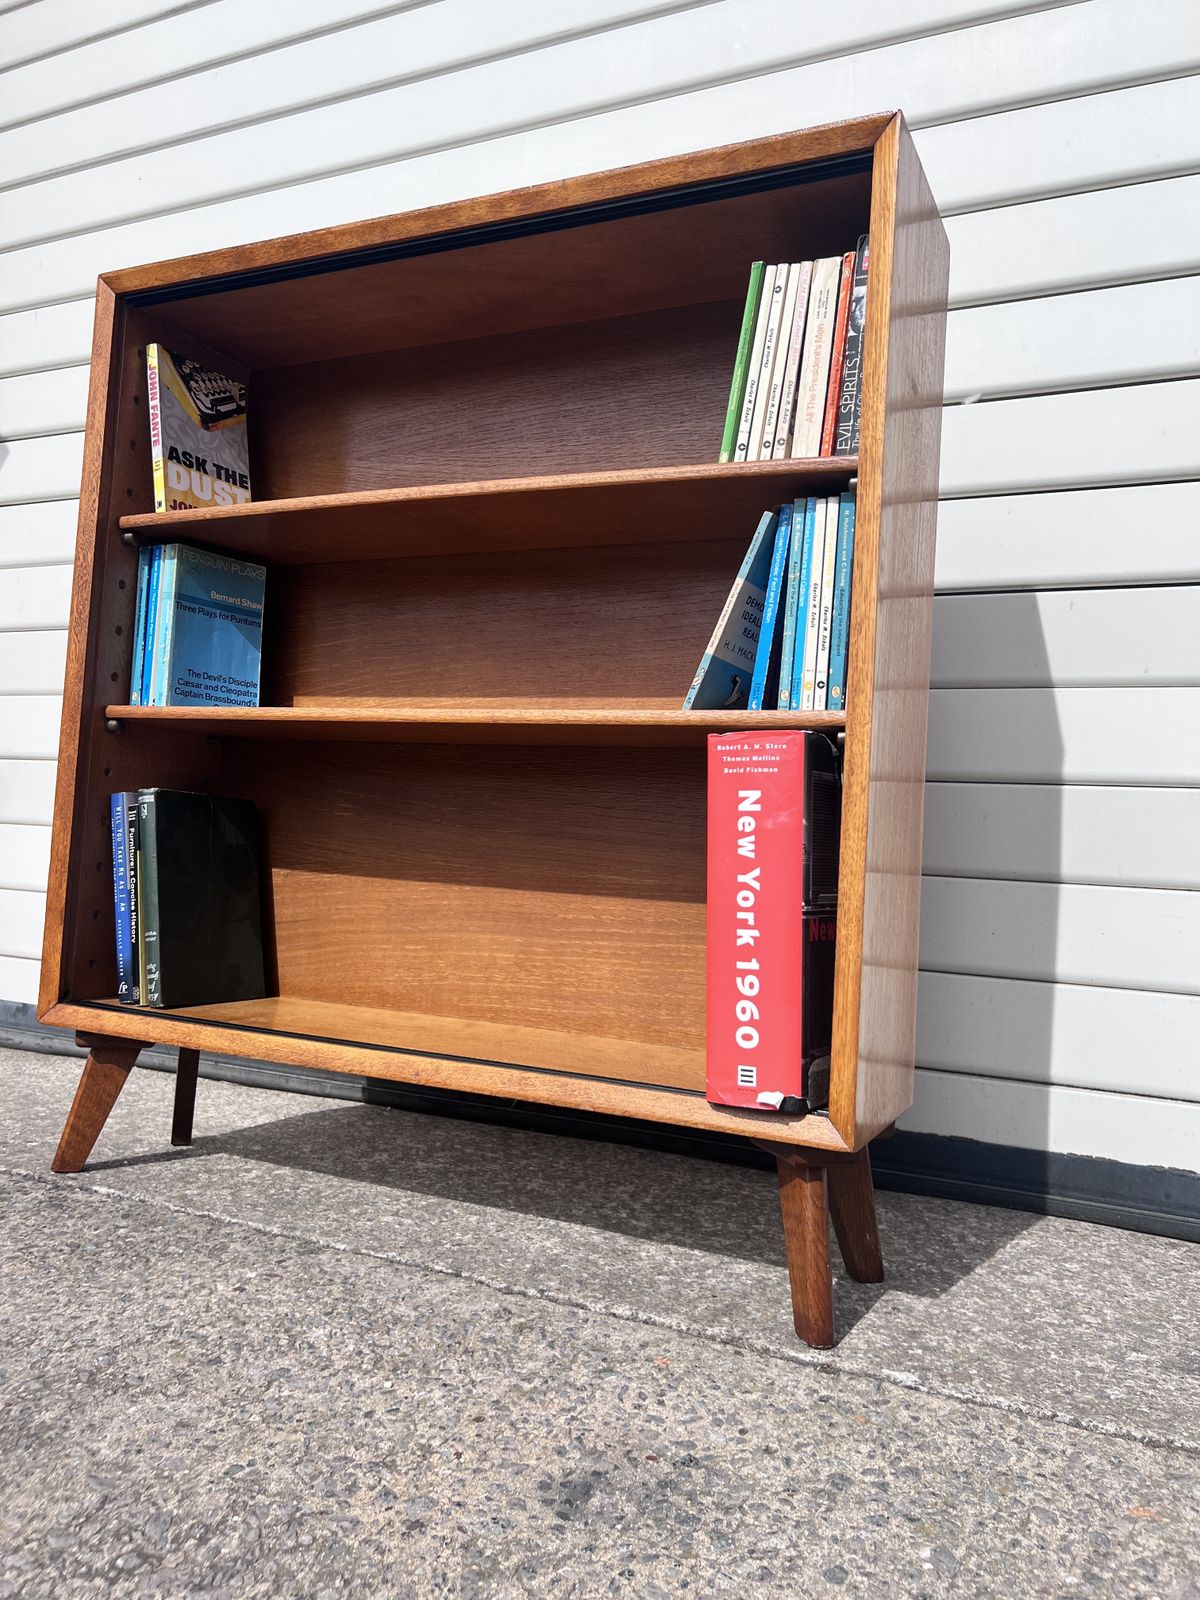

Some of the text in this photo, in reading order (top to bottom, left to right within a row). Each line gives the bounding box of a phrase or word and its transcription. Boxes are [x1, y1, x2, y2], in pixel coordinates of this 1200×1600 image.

[805, 323, 824, 423] All The President's Men
[748, 379, 756, 397] Charles
[770, 383, 778, 402] Charles
[841, 358, 859, 413] SPIRITS
[149, 363, 160, 447] JOHN FANTE
[836, 423, 853, 450] EVIL
[168, 446, 209, 475] ASK
[212, 463, 249, 490] THE
[168, 462, 251, 506] DUST
[169, 499, 198, 510] JO
[182, 550, 265, 580] PENGUIN PLAYS
[770, 576, 778, 591] Fact
[210, 590, 264, 609] Bernard Shaw
[745, 595, 765, 613] DEMO
[837, 588, 845, 615] Educating
[176, 601, 197, 613] Three
[197, 606, 218, 619] Plays
[219, 611, 230, 620] for
[230, 614, 262, 628] Puritans
[742, 609, 762, 629] IDEAL
[765, 603, 773, 624] Fiction
[742, 626, 759, 643] REAL
[186, 668, 258, 689] The Devil's Disciple
[174, 687, 204, 699] Captain
[205, 692, 257, 707] Brassbound's
[203, 683, 219, 692] and
[220, 685, 258, 698] Cleopatra
[118, 867, 123, 876] ME
[118, 880, 124, 889] AS
[119, 902, 125, 911] AM
[735, 790, 762, 1049] New York 1960
